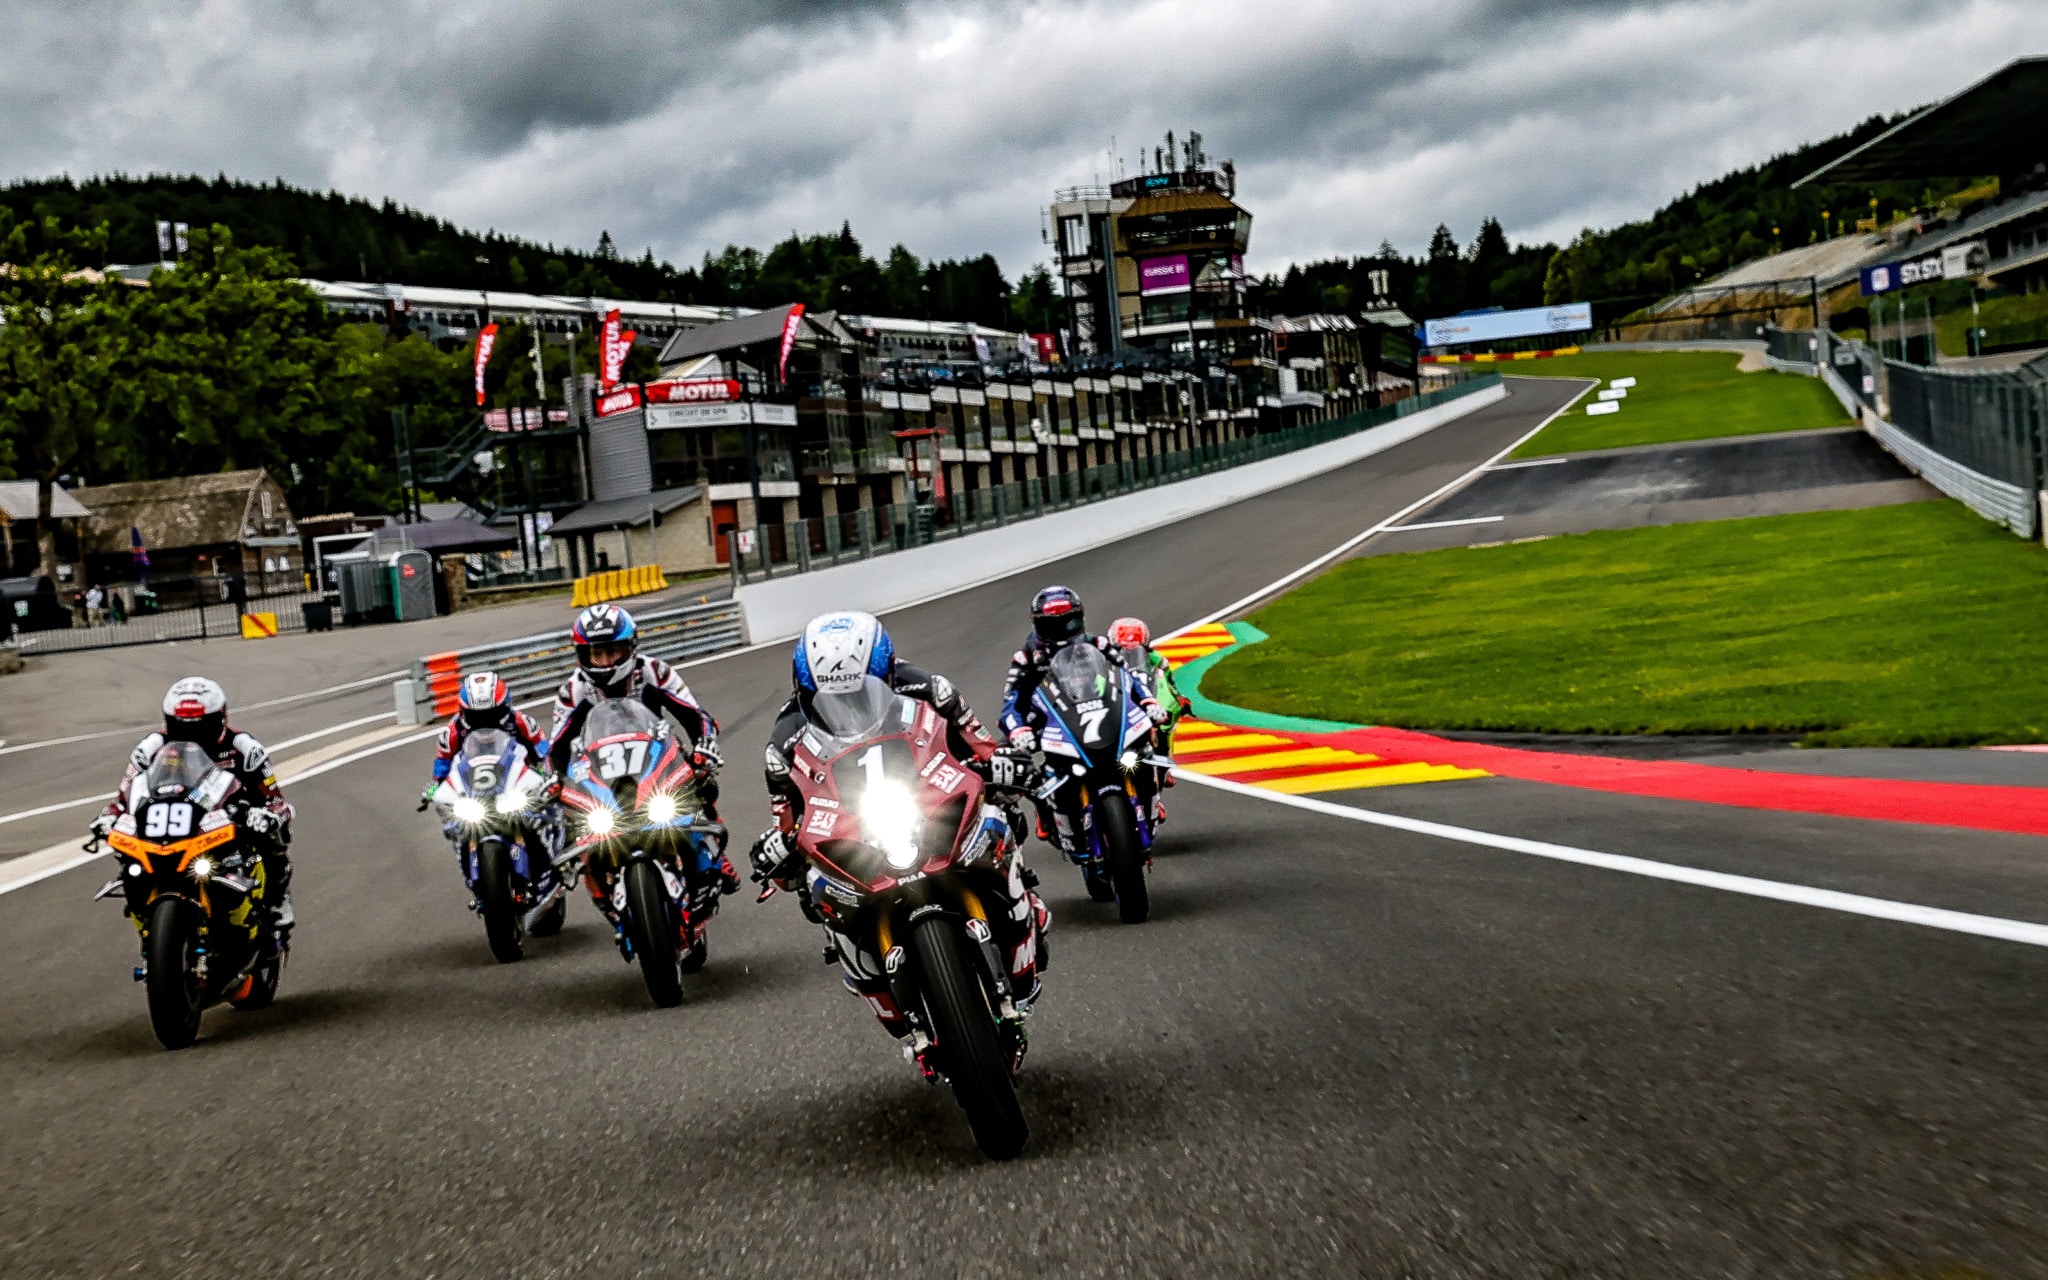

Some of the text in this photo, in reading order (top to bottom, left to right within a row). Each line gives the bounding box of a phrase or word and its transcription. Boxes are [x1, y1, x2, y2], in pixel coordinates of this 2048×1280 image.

[605, 321, 621, 381] MOTUL
[669, 383, 730, 401] MOTUL
[668, 408, 698, 417] CIRCUIT
[816, 672, 862, 683] SHARK
[1080, 708, 1110, 744] 7
[598, 740, 649, 780] 37
[473, 764, 497, 791] 5
[808, 796, 840, 809] SUZUKI
[145, 803, 193, 837] 99
[897, 870, 927, 886] PIAA
